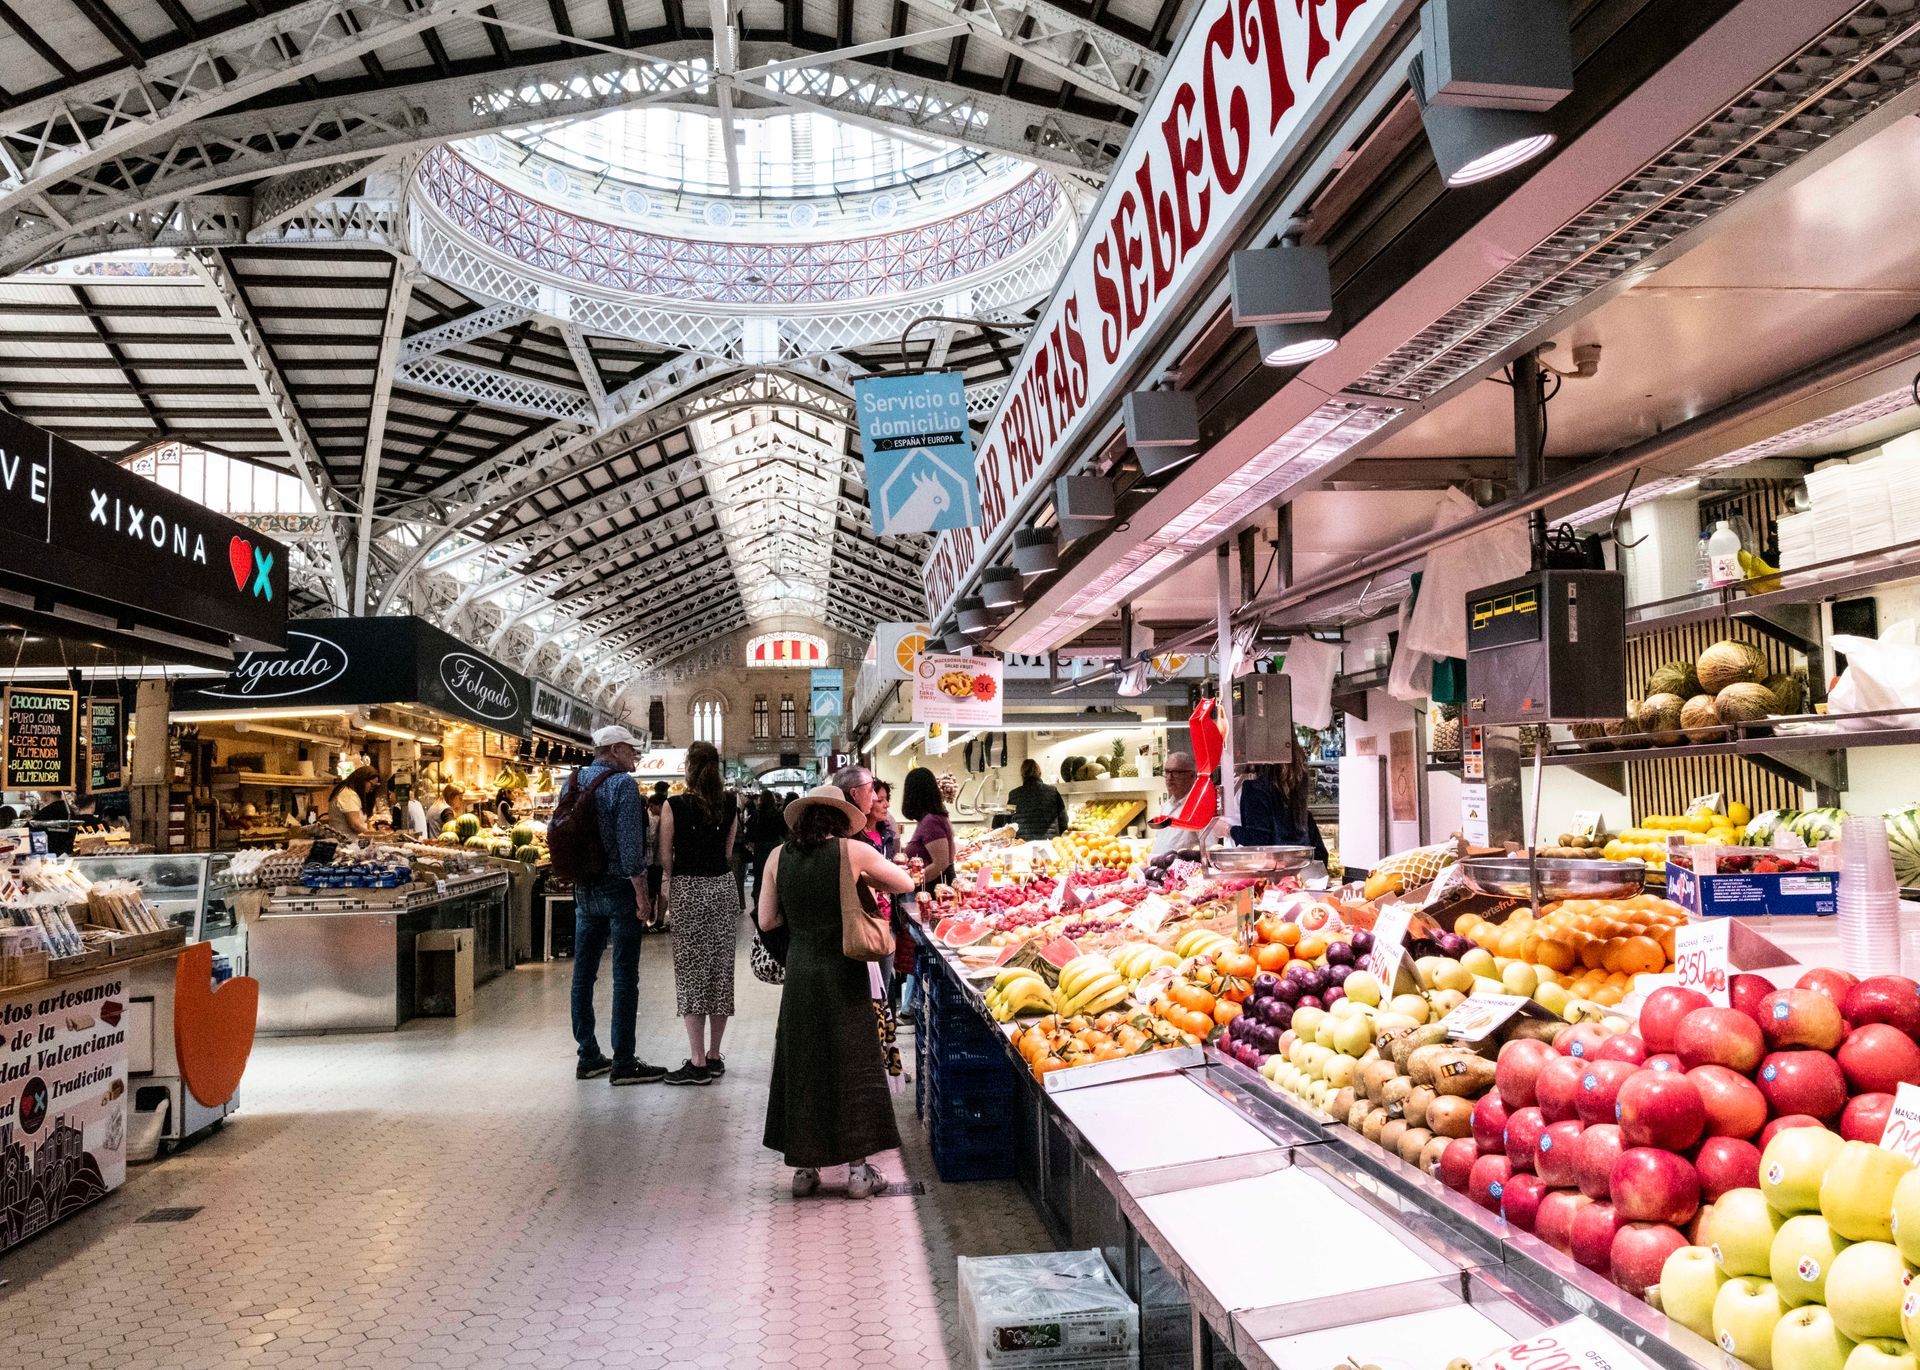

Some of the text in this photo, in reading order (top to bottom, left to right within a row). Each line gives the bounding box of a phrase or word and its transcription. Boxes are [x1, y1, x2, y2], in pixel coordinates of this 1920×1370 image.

[864, 389, 960, 413] Servicio a
[870, 411, 961, 436] domicilio
[894, 435, 955, 448] ESPAÑA Y EUROPA
[924, 536, 955, 623] FRUTAS
[1001, 289, 1089, 500] FRUTAS
[90, 488, 207, 565] XIXONA
[451, 658, 512, 711] Folgado
[978, 682, 991, 693] 3€
[10, 695, 70, 711] CHOCOLATES
[12, 712, 54, 723] PURO CON
[19, 725, 61, 735] ALMENDRA
[12, 736, 57, 746] LECHE CON
[16, 748, 59, 758] ALMENDRA
[11, 760, 61, 770] BLANCO CON
[16, 771, 59, 782] ALMENDRA
[1481, 898, 1518, 919] ortefrut
[0, 979, 122, 1026] tos artesanos
[11, 1023, 55, 1052] de la
[37, 1029, 125, 1072] Valenciana
[52, 1063, 113, 1100] Tradición
